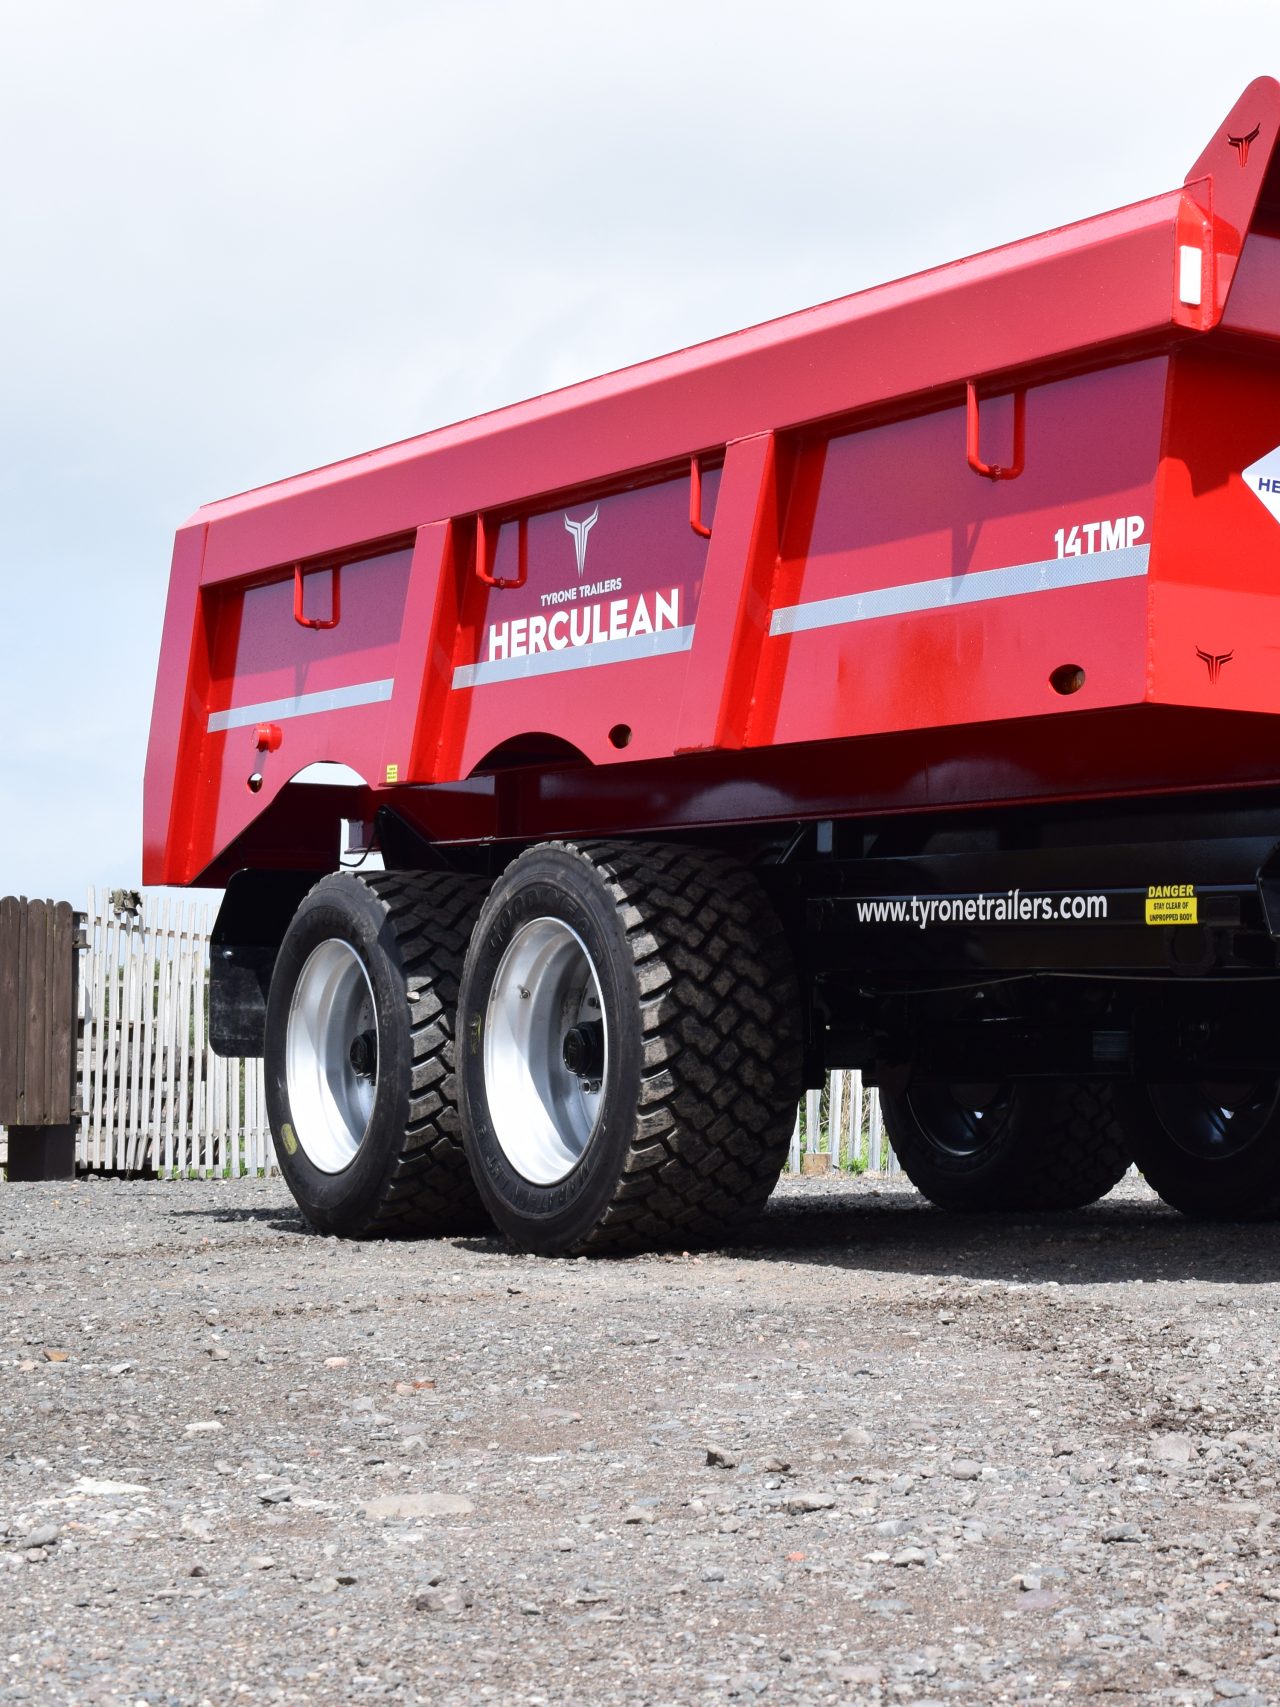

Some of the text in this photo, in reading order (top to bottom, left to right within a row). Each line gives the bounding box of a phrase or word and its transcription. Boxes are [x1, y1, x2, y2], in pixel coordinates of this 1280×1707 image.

[1054, 515, 1145, 559] 14TMP
[541, 577, 622, 607] TYRONE TRAILERS
[488, 588, 679, 662] HERCULEAN
[857, 888, 1108, 929] www.tyronetrailers.com
[1149, 885, 1194, 897] DANGER
[1154, 902, 1165, 910] STAY
